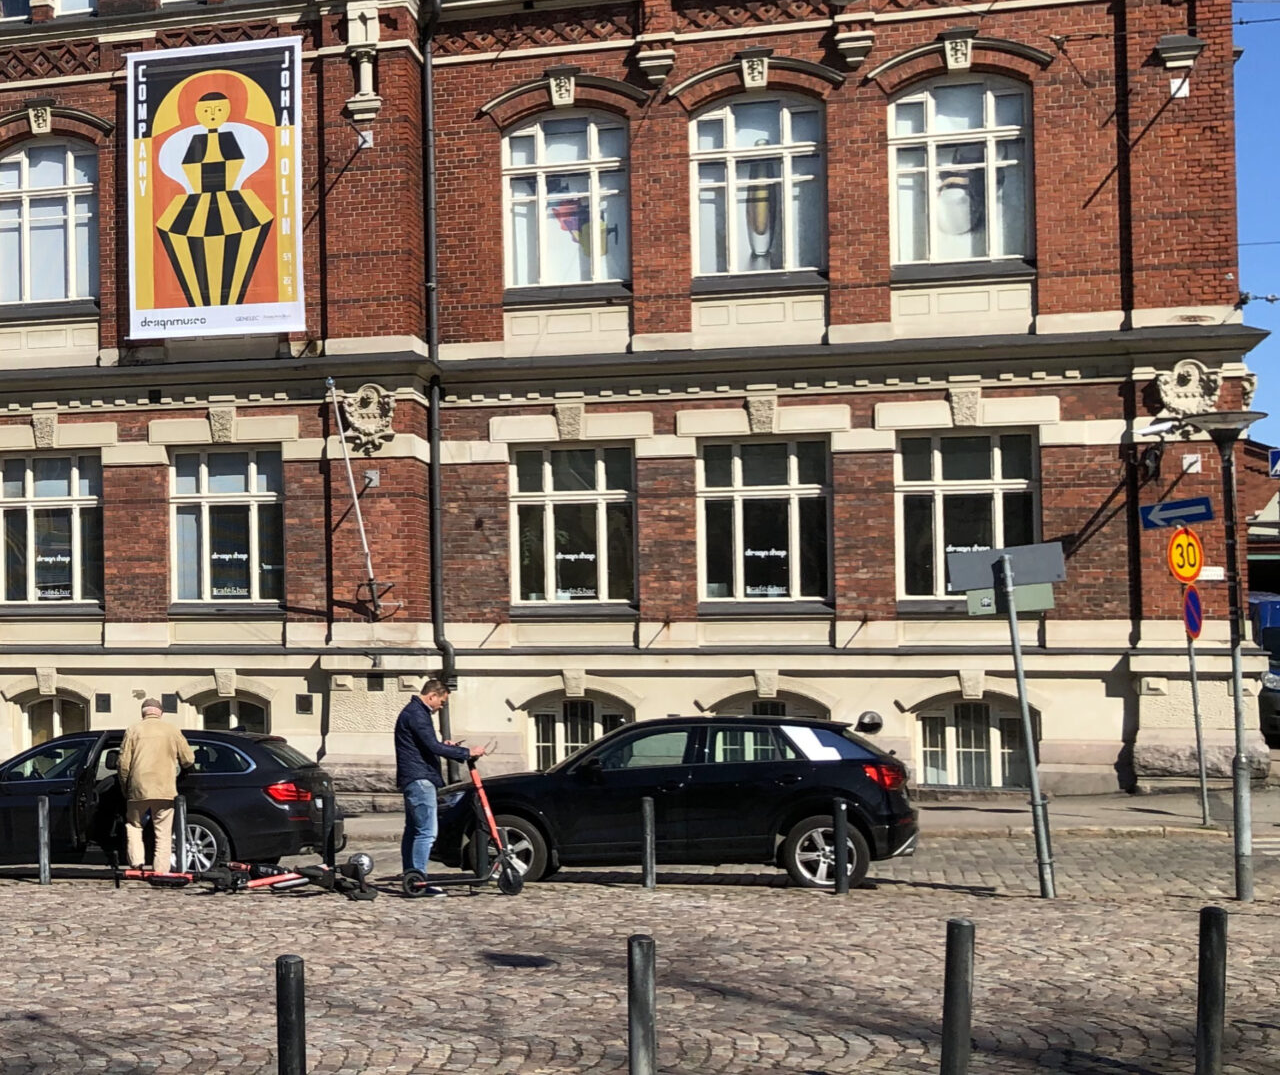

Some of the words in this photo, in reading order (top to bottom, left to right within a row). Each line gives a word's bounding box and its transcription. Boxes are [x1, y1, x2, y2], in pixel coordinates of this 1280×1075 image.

[137, 64, 147, 198] COMPANY
[280, 50, 290, 147] JOHAN
[280, 156, 291, 236] OLIN
[140, 315, 207, 330] designmuseo
[1176, 542, 1197, 569] 30
